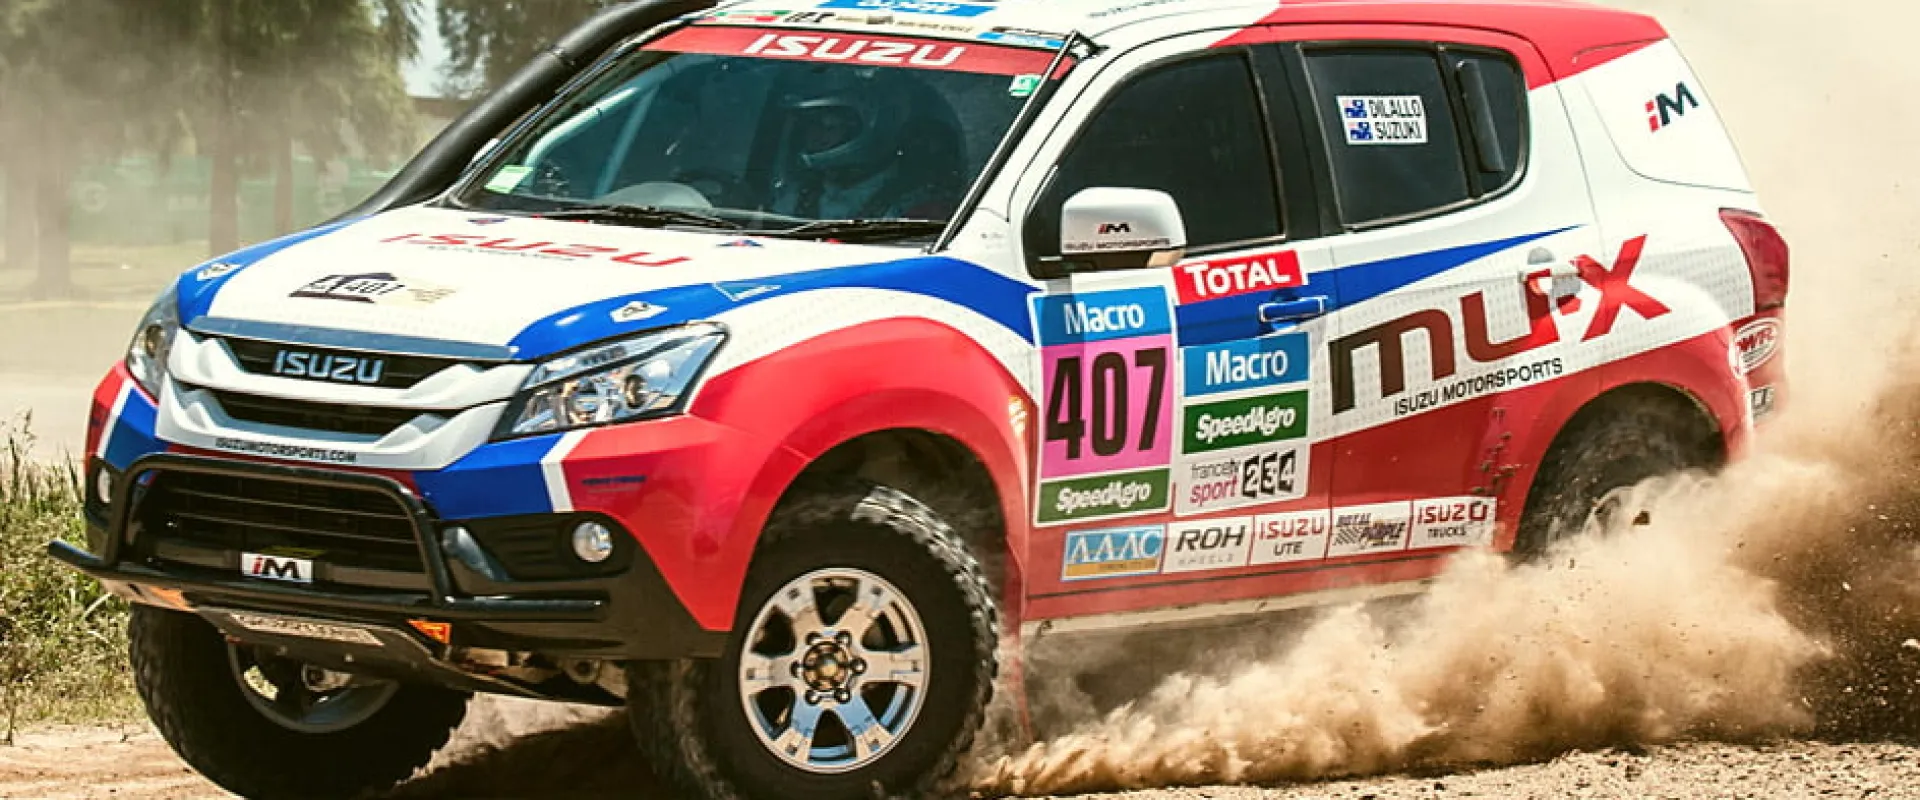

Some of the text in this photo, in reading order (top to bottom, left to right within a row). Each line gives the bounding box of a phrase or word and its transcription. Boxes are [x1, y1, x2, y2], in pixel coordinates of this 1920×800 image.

[744, 33, 965, 66] ISUZU
[1369, 99, 1421, 118] DILALLO
[1375, 122, 1423, 139] SUZUKI
[378, 233, 694, 266] ISUZU
[1184, 257, 1292, 297] TOTAL
[1064, 301, 1144, 334] Macro
[273, 349, 384, 384] ISUZU
[1206, 349, 1289, 386] Macro
[1046, 347, 1167, 460] 407
[1394, 358, 1563, 416] ISUZU MOTORSPORTS
[1196, 405, 1297, 443] SpeedAgro
[215, 437, 358, 463] ISUZUMOTORSPORTS.COM
[1056, 480, 1152, 514] SpeedAgro
[1190, 475, 1238, 507] sport
[1259, 517, 1324, 541] ISUZU
[1417, 500, 1489, 525] ISUZU
[1070, 530, 1162, 564] AAAC
[1175, 525, 1246, 552] ROH
[1428, 526, 1466, 538] TRUCKS
[1273, 541, 1303, 557] UTE
